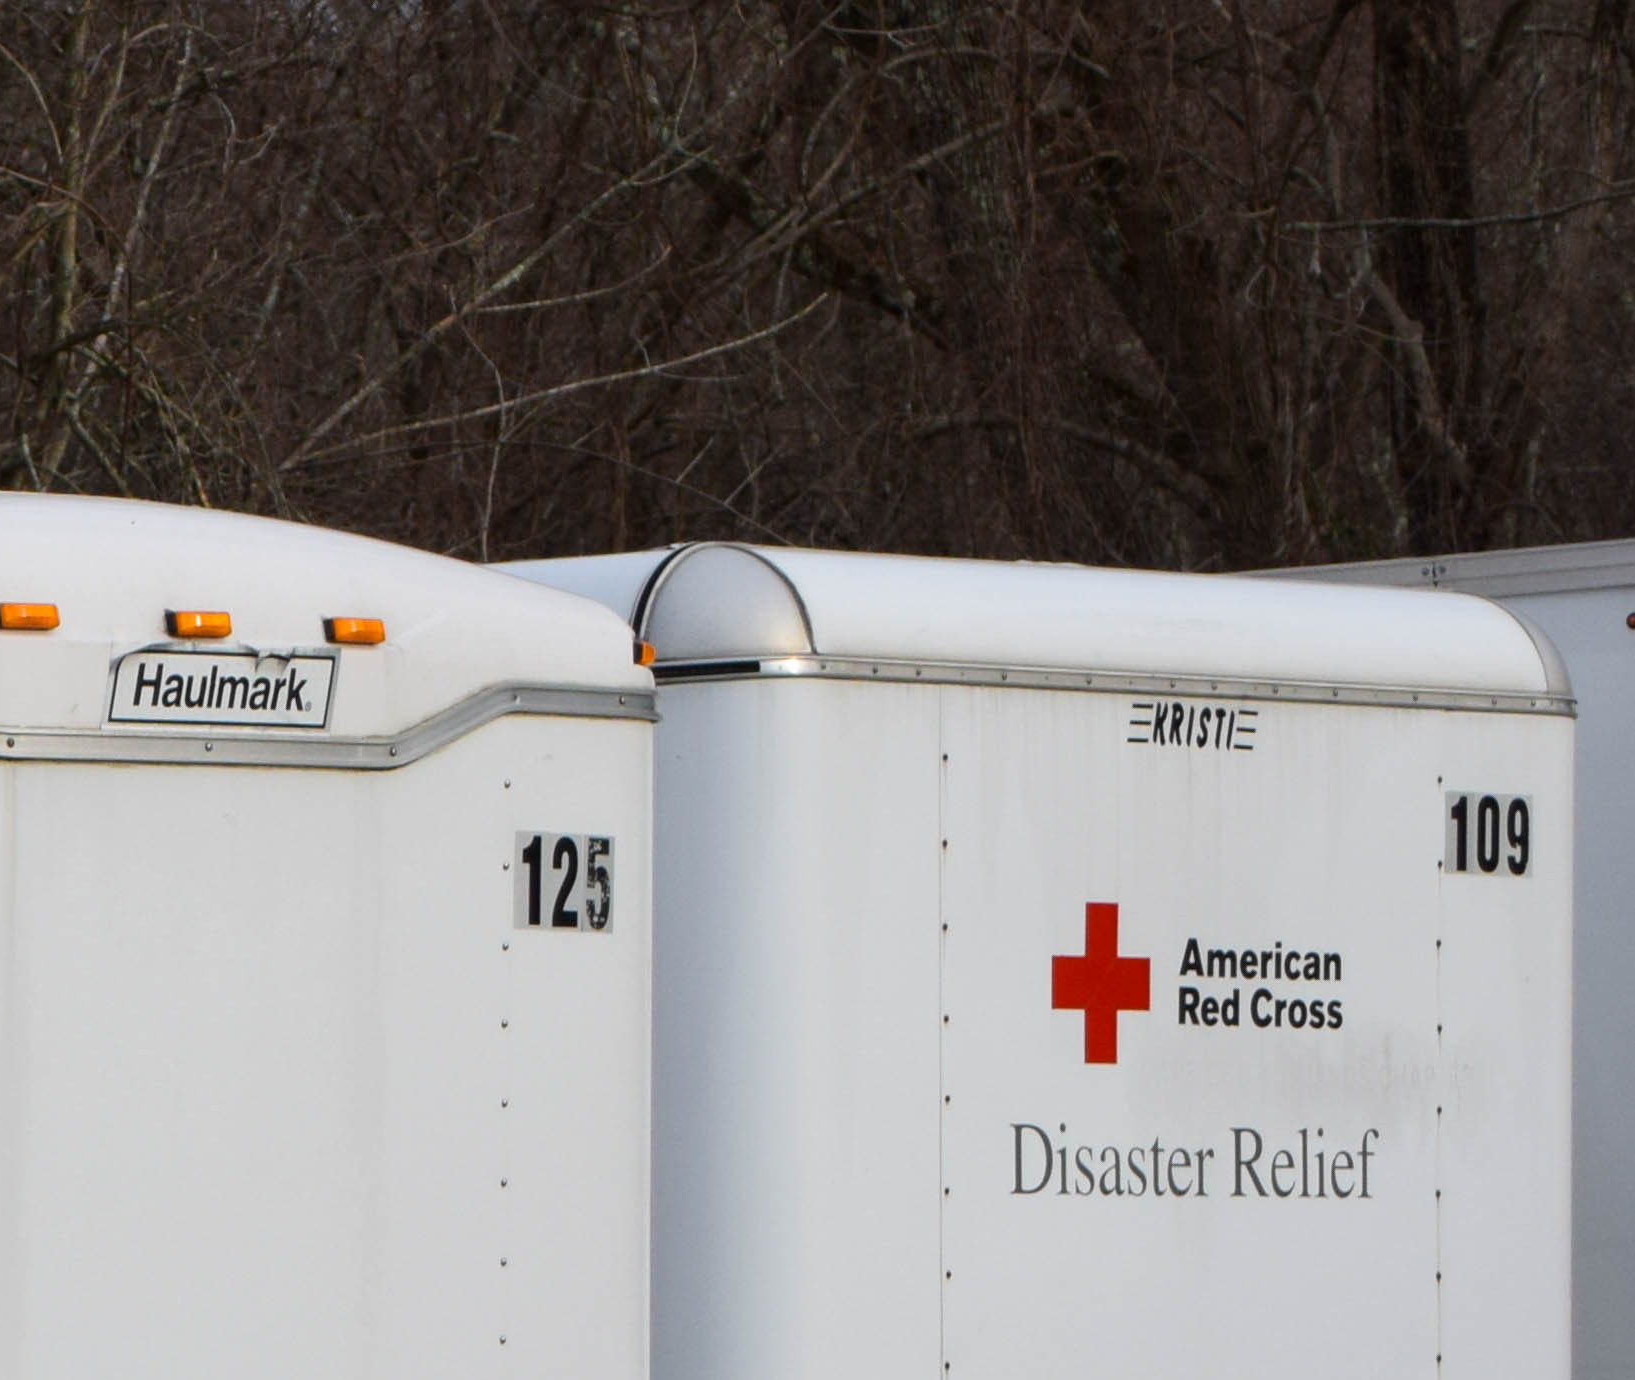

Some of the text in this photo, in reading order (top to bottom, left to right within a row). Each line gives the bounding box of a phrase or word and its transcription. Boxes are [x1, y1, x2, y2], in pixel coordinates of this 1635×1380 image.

[1152, 702, 1235, 750] KRISTI
[1450, 794, 1530, 876] 109
[522, 834, 611, 930] 125
[1179, 938, 1342, 982] American
[1178, 986, 1344, 1029] Red Cross
[1009, 1122, 1380, 1199] Disaster Relief
